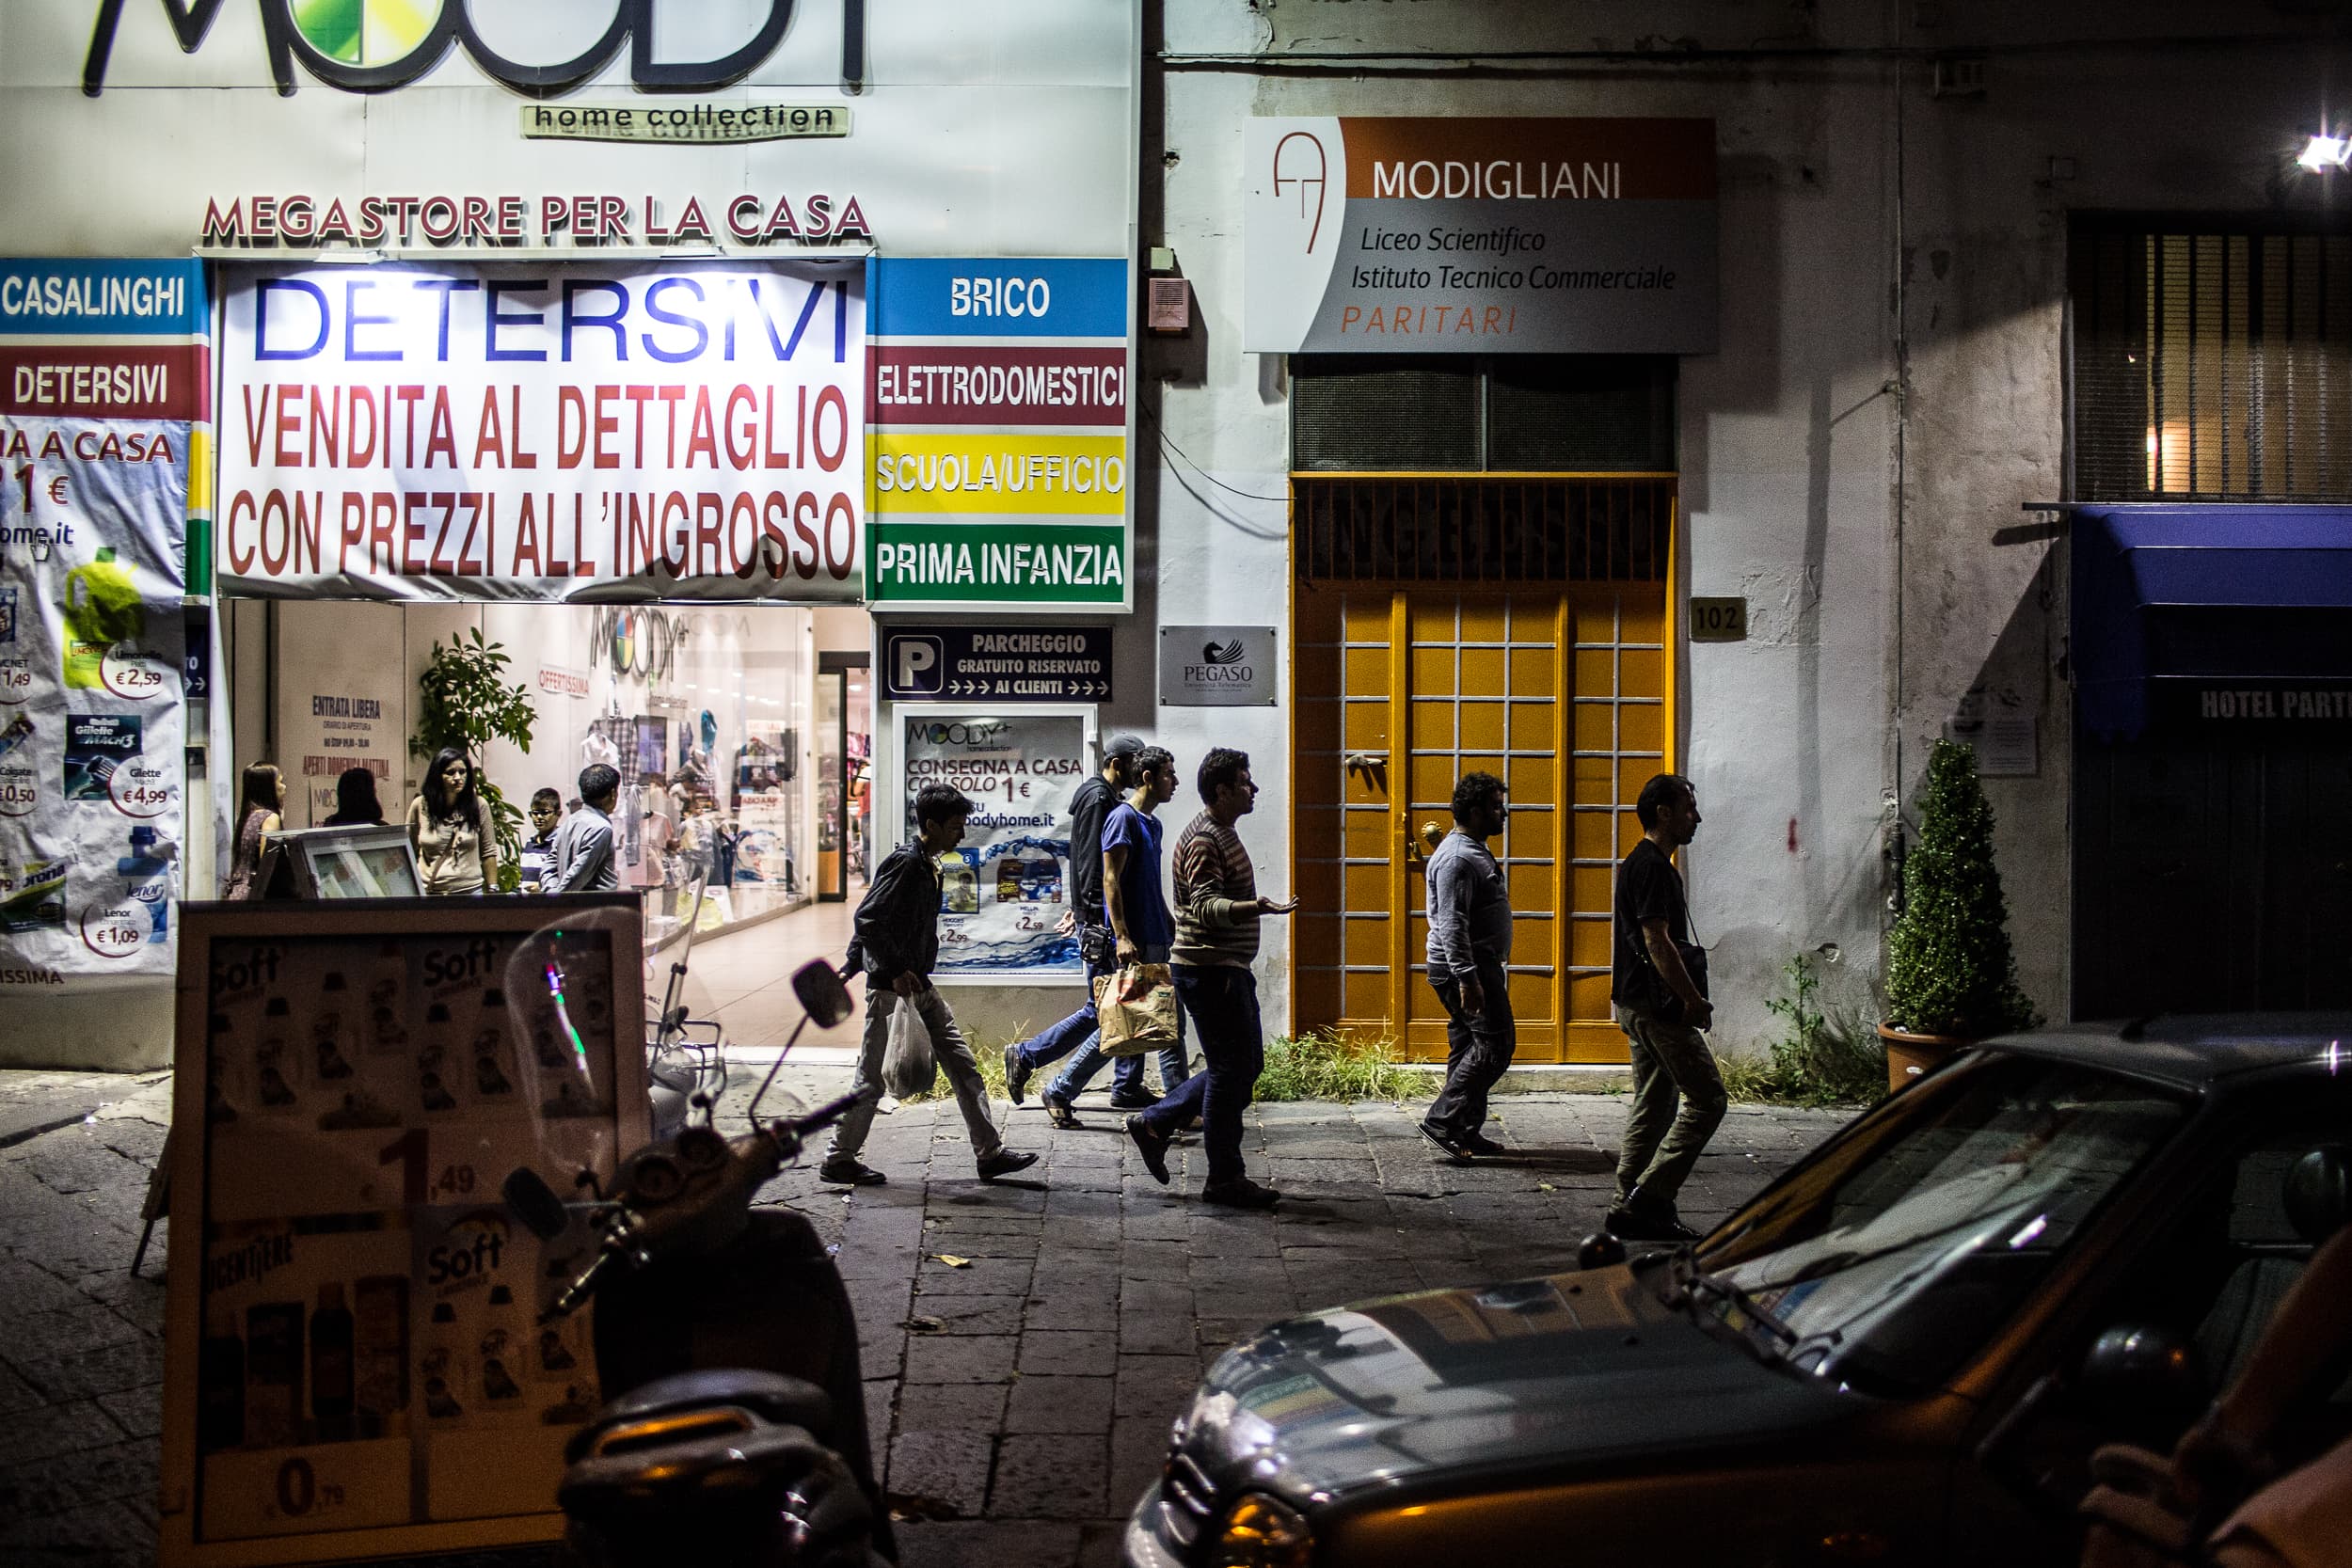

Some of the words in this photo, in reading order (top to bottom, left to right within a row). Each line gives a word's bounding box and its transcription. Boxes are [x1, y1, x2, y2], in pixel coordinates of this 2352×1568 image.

[534, 104, 633, 127] home
[646, 103, 834, 127] collection
[1373, 160, 1621, 200] MODIGLIANI
[200, 194, 523, 241] MEGASTORE
[540, 194, 630, 239] PER
[644, 194, 711, 239] LA
[726, 194, 872, 239] CASA
[1360, 227, 1421, 252] Liceo
[1426, 227, 1546, 258] Scientifico
[1351, 264, 1431, 291] Istituto
[1438, 264, 1523, 291] Tecnico
[1528, 264, 1677, 292] Commerciale
[2, 276, 185, 318] CASALINGHI
[949, 277, 1052, 318] BRICO
[255, 277, 848, 365] DETERSIVI
[1341, 306, 1518, 335] PARITARI
[14, 364, 168, 405] DETERSIVI
[877, 365, 1125, 407] ELETTRODOMESTICI
[242, 383, 457, 469] VENDITA
[475, 384, 537, 469] AL
[557, 382, 849, 472] DETTAGLIO
[39, 430, 66, 460] A
[73, 429, 175, 464] CASA
[876, 451, 1125, 494] SCUOLA/UFFICIO
[14, 462, 36, 515] 1
[227, 488, 325, 578] CON
[339, 490, 496, 578] PREZZI
[511, 489, 857, 581] ALL'INGROSSO
[876, 542, 976, 585] PRIMA
[981, 542, 1123, 585] INFANZIA
[1695, 606, 1739, 630] 102
[971, 633, 1087, 654] PARCHEGGIO
[898, 641, 936, 688] P
[956, 658, 1025, 674] GRATUITO
[1026, 658, 1102, 674] RISERVATO
[1184, 665, 1253, 682] PEGASO
[538, 669, 590, 695] OFFERTISSIMA
[995, 680, 1011, 694] AI
[1013, 679, 1063, 695] CLIENTI
[312, 695, 350, 718] ENTRATA
[352, 697, 381, 720] LIBERA
[2201, 690, 2277, 719] HOTEL
[906, 759, 1010, 775] CONSEGNA
[1014, 759, 1028, 775] A
[1032, 758, 1083, 775] CASA
[134, 786, 167, 806] 4,99
[950, 776, 996, 793] SOLO
[1001, 777, 1012, 802] 1
[104, 909, 131, 917] Lenor
[109, 927, 139, 945] 1,09
[424, 939, 497, 987] Soft
[428, 1234, 501, 1287] Soft
